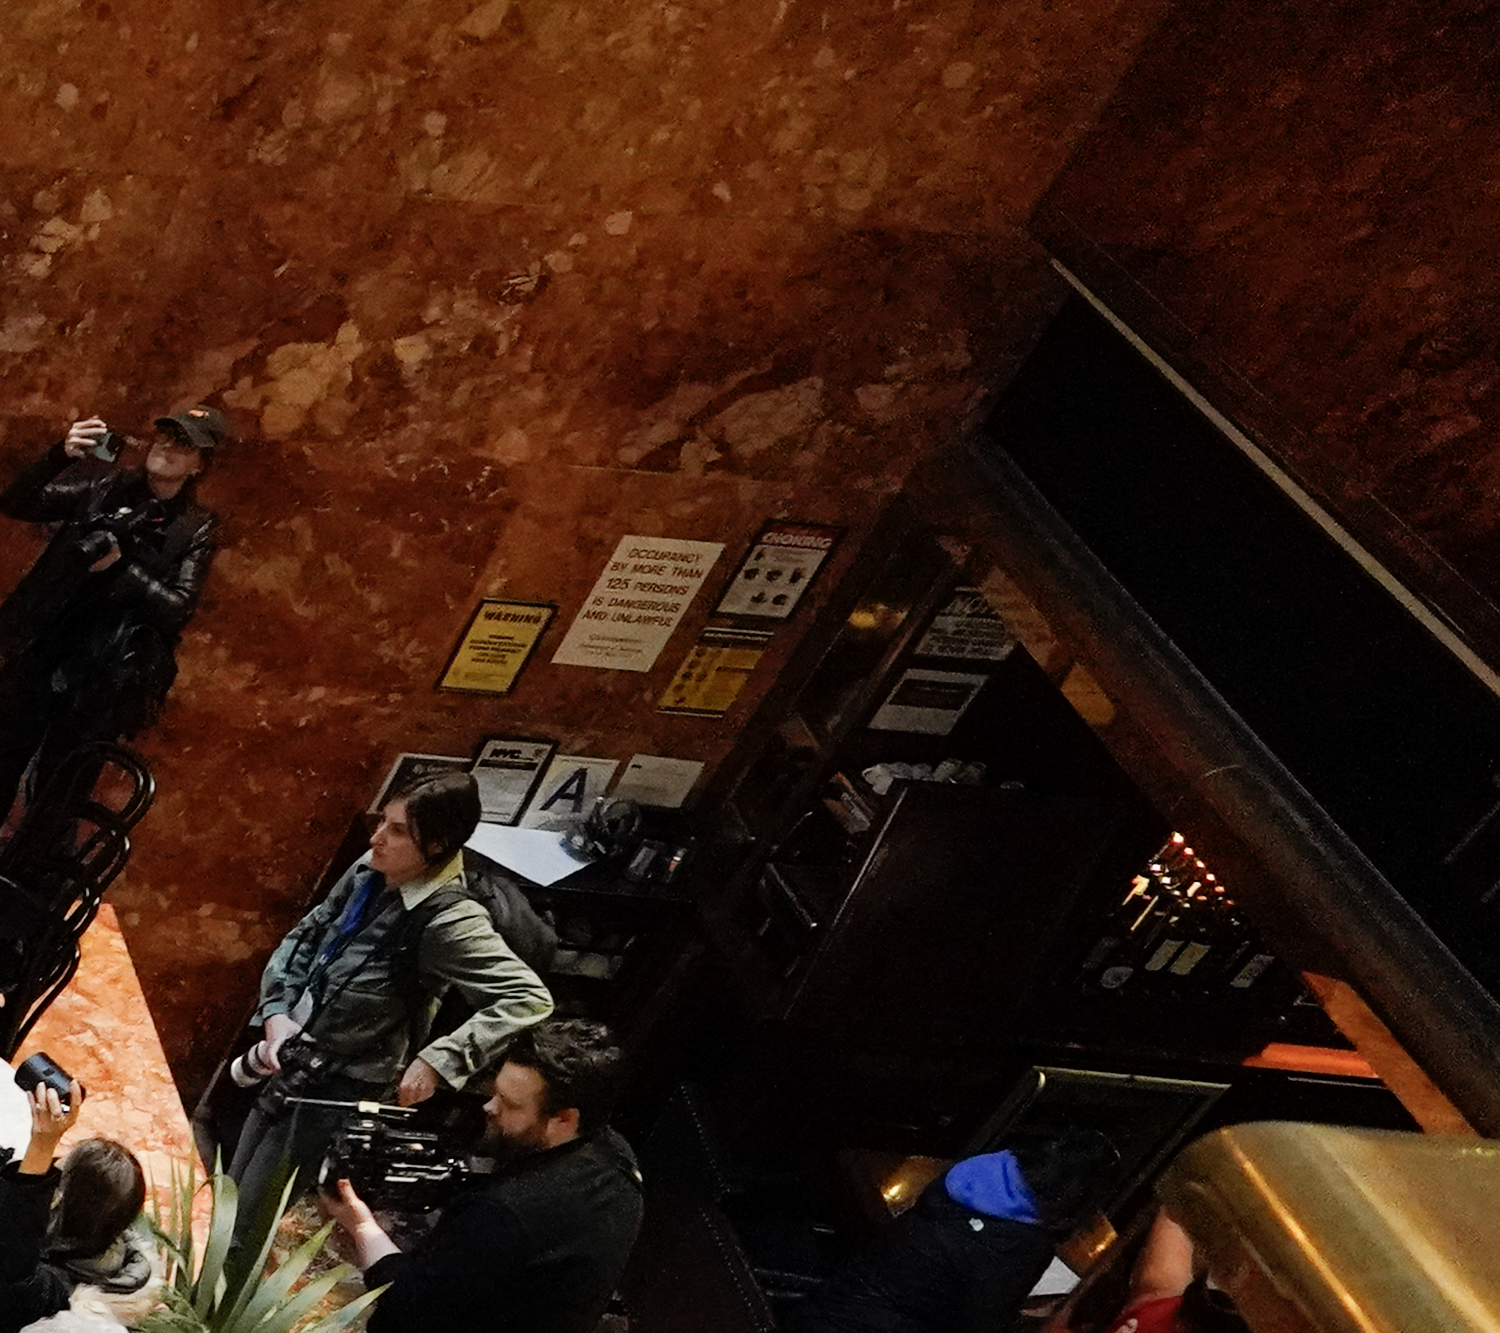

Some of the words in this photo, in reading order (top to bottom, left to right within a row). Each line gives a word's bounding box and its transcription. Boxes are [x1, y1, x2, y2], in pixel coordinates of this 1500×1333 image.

[627, 548, 702, 563] OCCUPANCY
[610, 562, 626, 573] BY
[631, 564, 669, 576] MORE
[671, 566, 704, 579] THAN
[606, 578, 630, 590] 125
[635, 581, 690, 595] PERSONS
[607, 598, 682, 614] DANGEROUS
[583, 609, 607, 621] AND
[610, 611, 674, 627] UNLAWFUL
[547, 768, 590, 814] A
